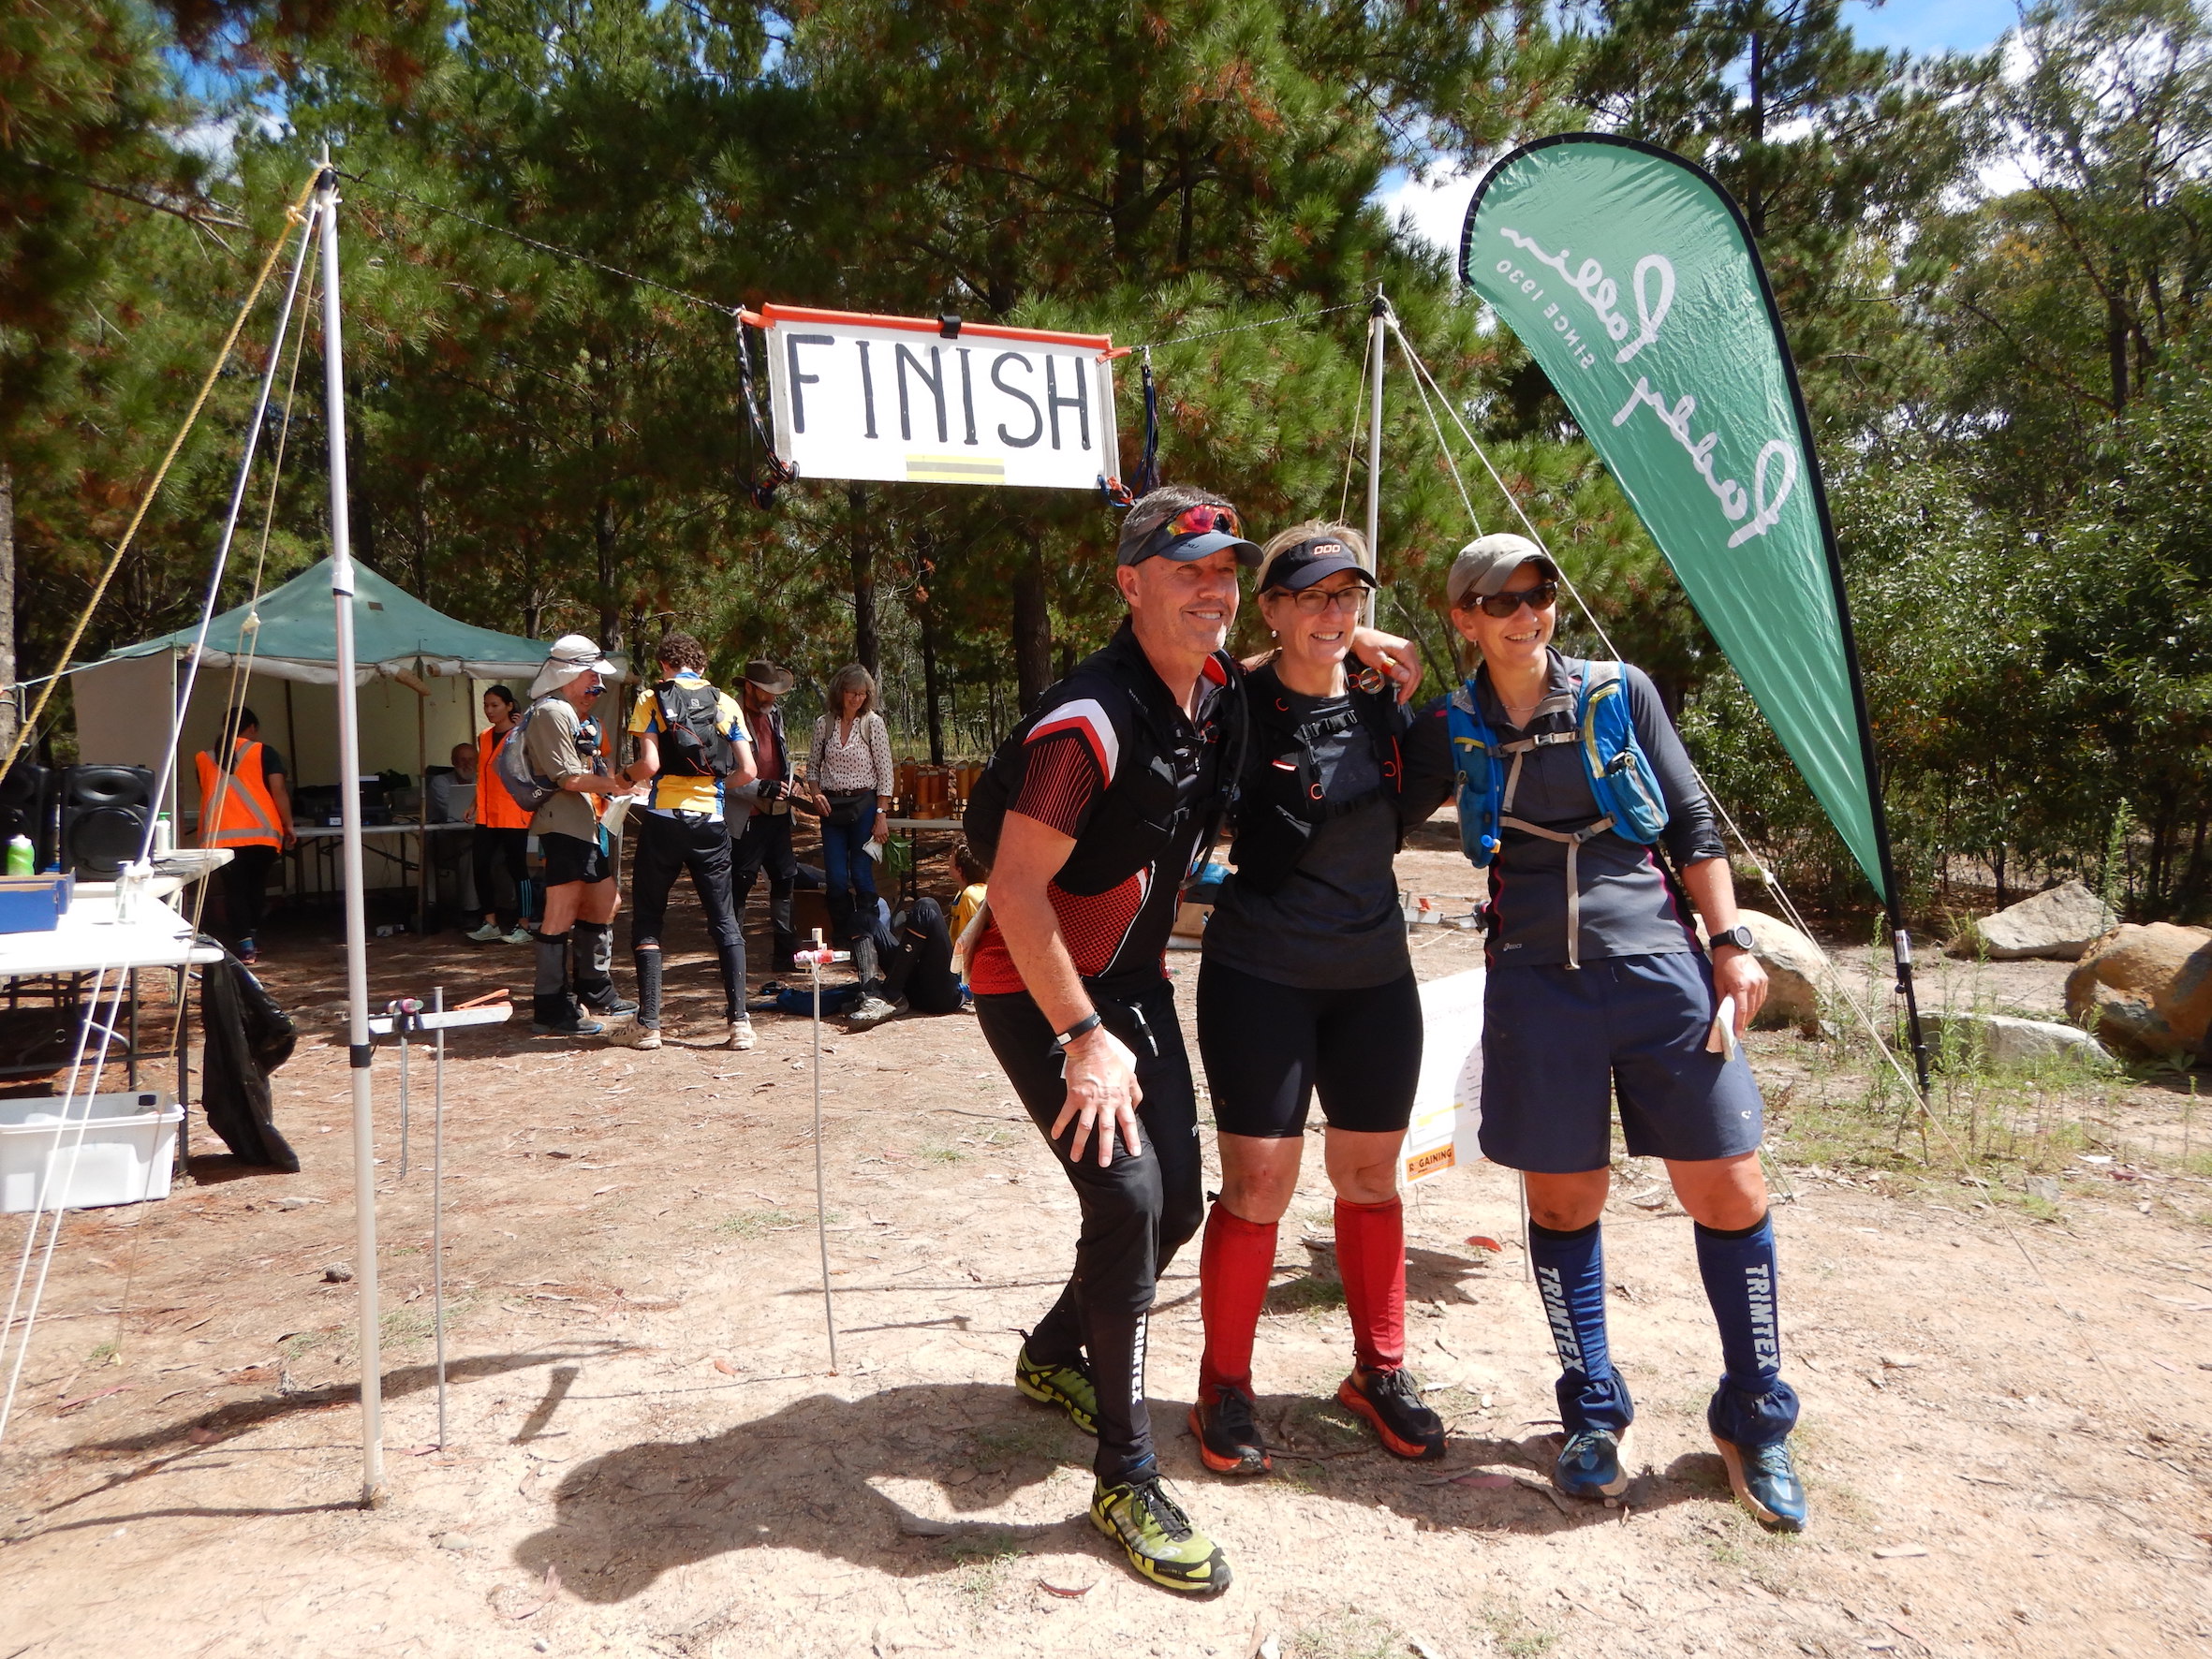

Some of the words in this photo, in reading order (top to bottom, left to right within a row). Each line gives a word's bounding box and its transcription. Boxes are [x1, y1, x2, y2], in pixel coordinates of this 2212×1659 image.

[787, 332, 1092, 451] FINISH
[1408, 1148, 1453, 1172] RGAINING
[1131, 1312, 1147, 1405] TRIMTEX
[1538, 1267, 1585, 1373] TRIMTEX
[1745, 1264, 1779, 1370] TRIMTEX
